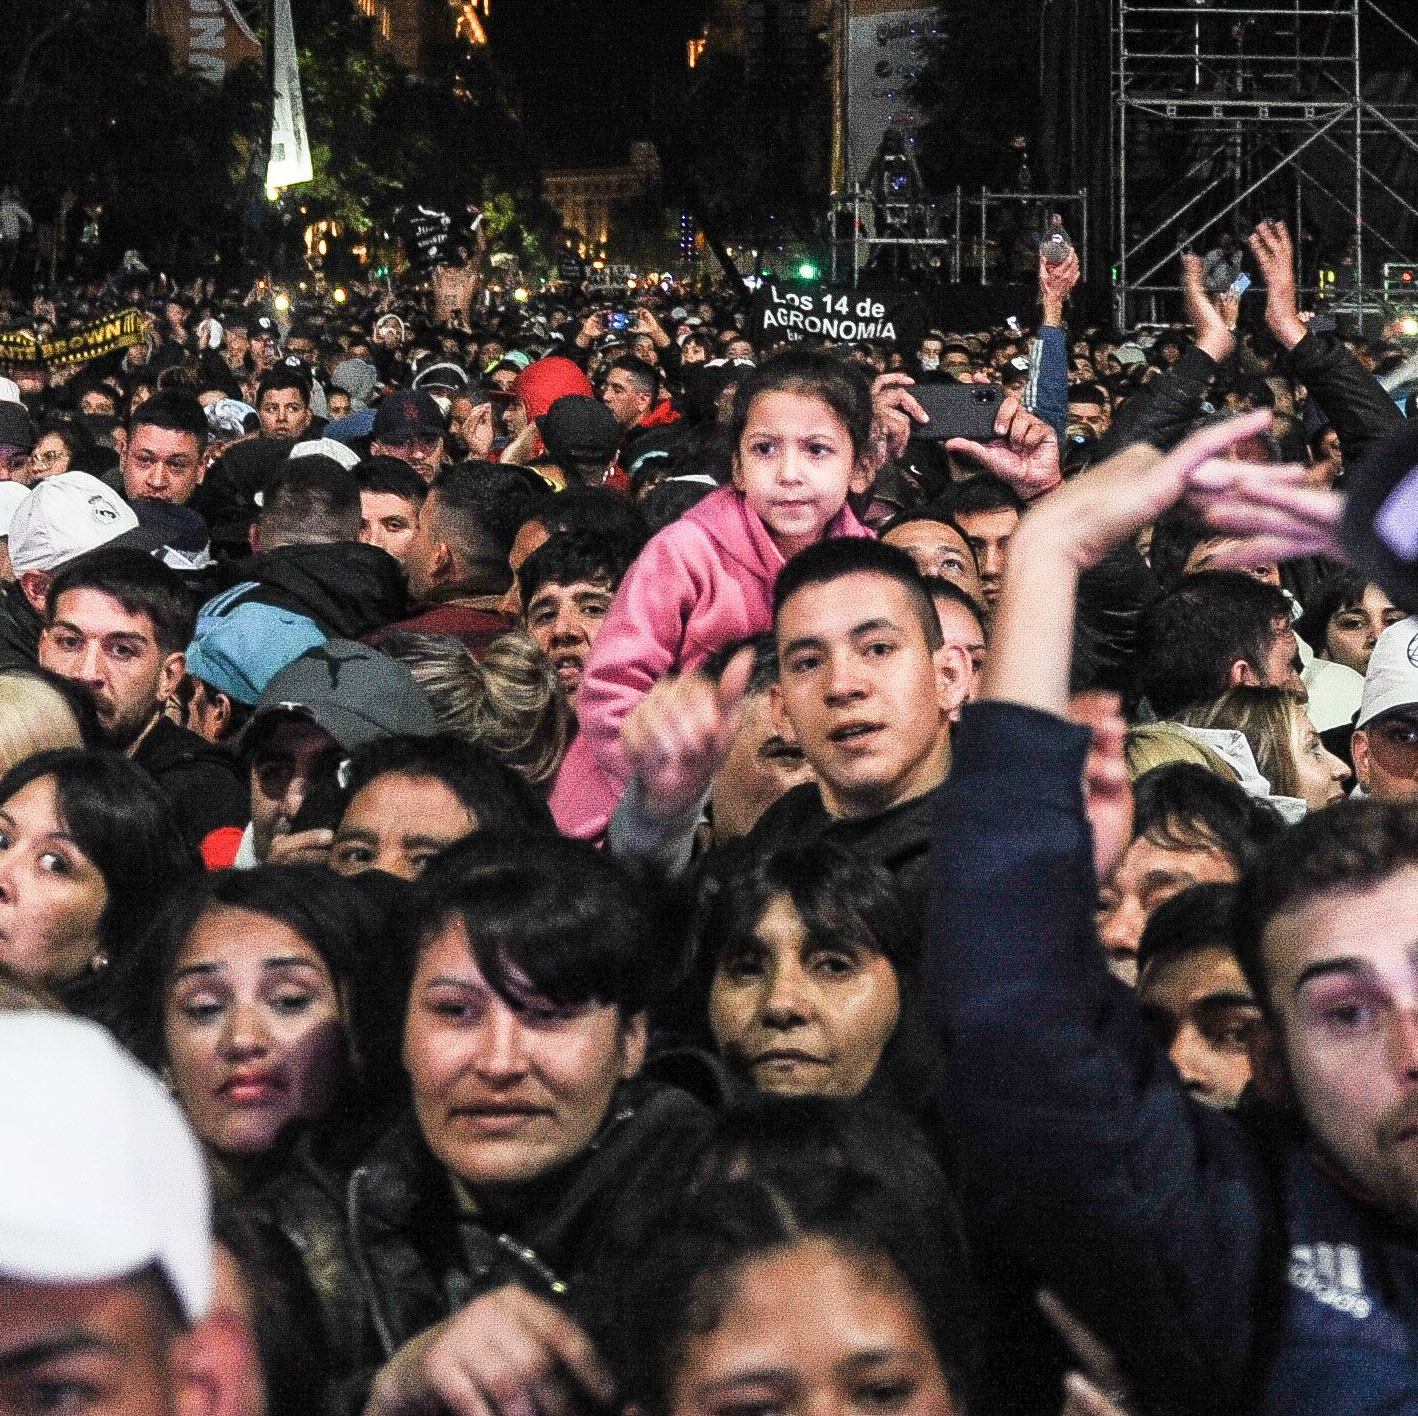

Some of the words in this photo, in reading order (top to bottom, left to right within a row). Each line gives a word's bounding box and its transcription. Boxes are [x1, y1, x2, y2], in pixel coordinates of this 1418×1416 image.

[771, 284, 814, 312] Los
[822, 293, 849, 316] 14
[855, 297, 886, 319] de
[41, 318, 122, 360] BROWN
